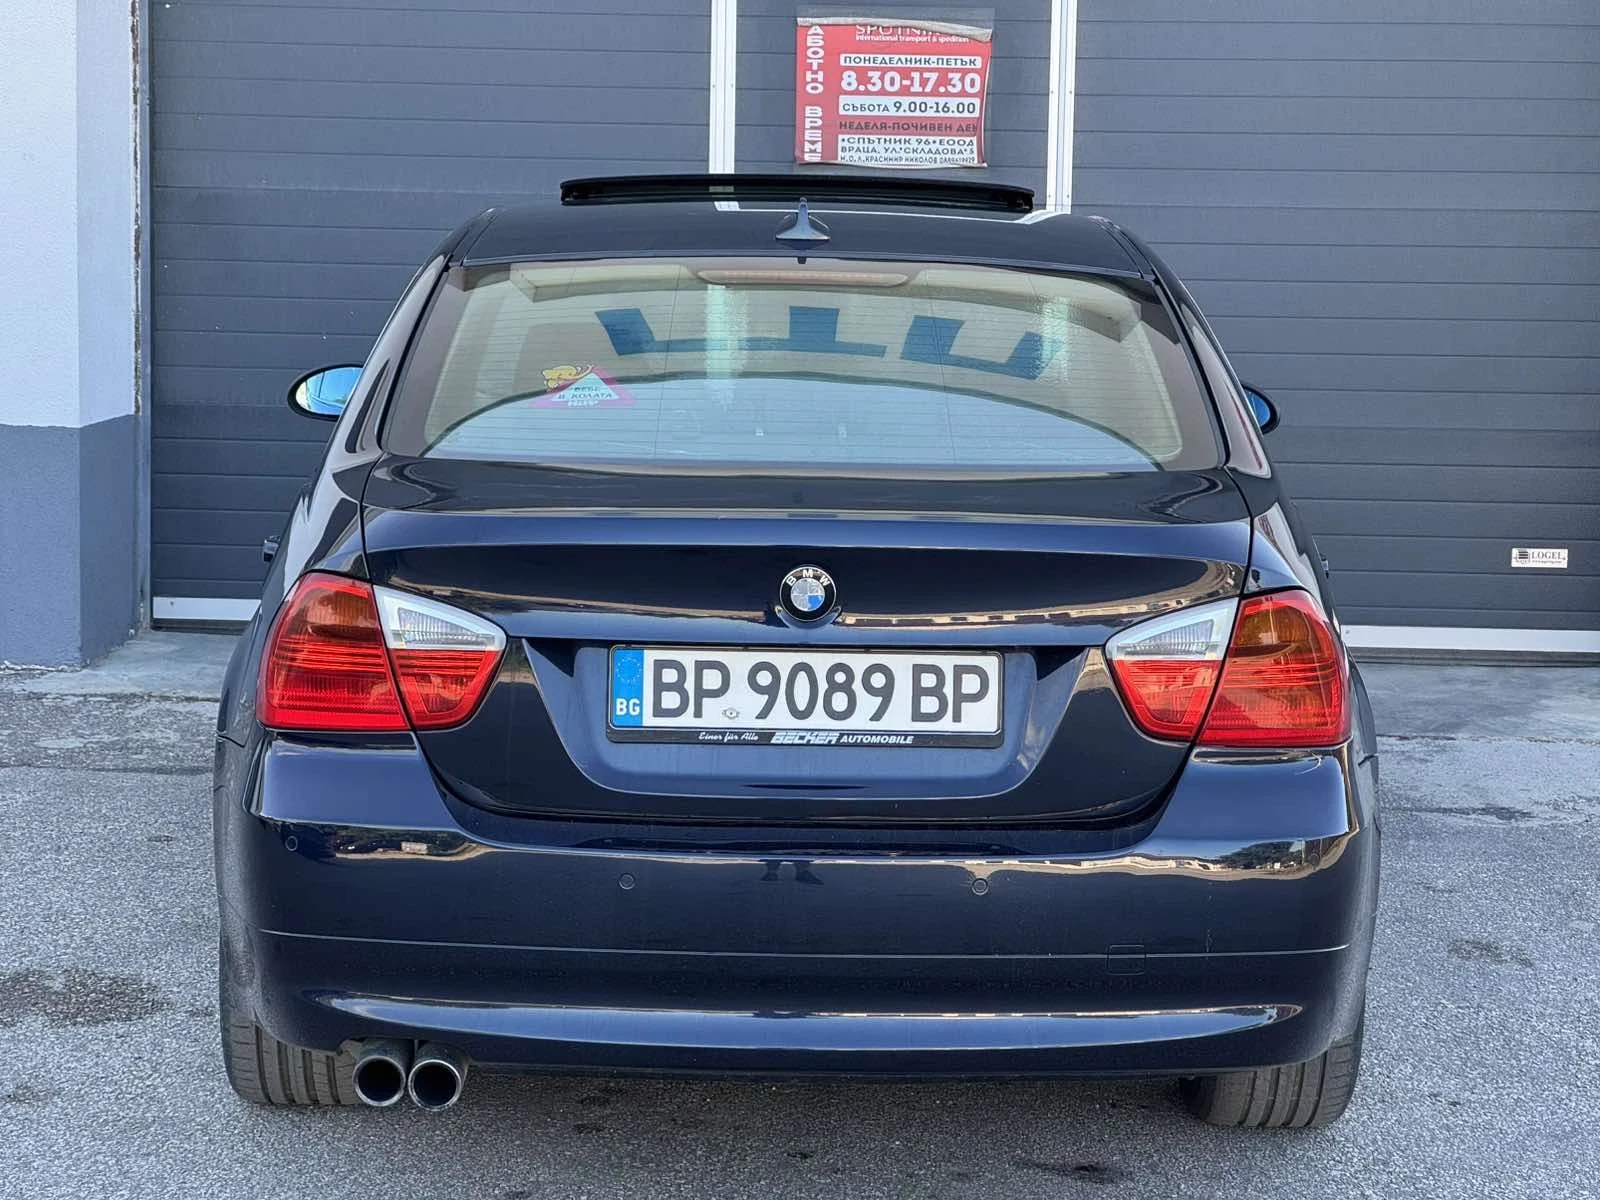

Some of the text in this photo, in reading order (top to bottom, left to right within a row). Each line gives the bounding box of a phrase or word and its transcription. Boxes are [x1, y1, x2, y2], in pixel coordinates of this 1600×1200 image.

[899, 35, 931, 43] transport
[806, 25, 825, 94] АБОТНО
[844, 56, 977, 67] ПОНЕДЕЛНИК-ПЕТЪК
[841, 70, 981, 94] 8.30-17.30
[842, 101, 976, 113] СЪБОТА 9.00-16.00
[840, 121, 953, 132] НЕДЕЛЯ-ПОЧИВЕН
[786, 569, 831, 586] BMW
[652, 659, 990, 723] BP 9089 BP
[615, 698, 640, 715] BG
[698, 731, 723, 741] Einer
[724, 731, 738, 743] für
[740, 732, 759, 741] Alle
[840, 735, 914, 744] AUTOMOBILE
